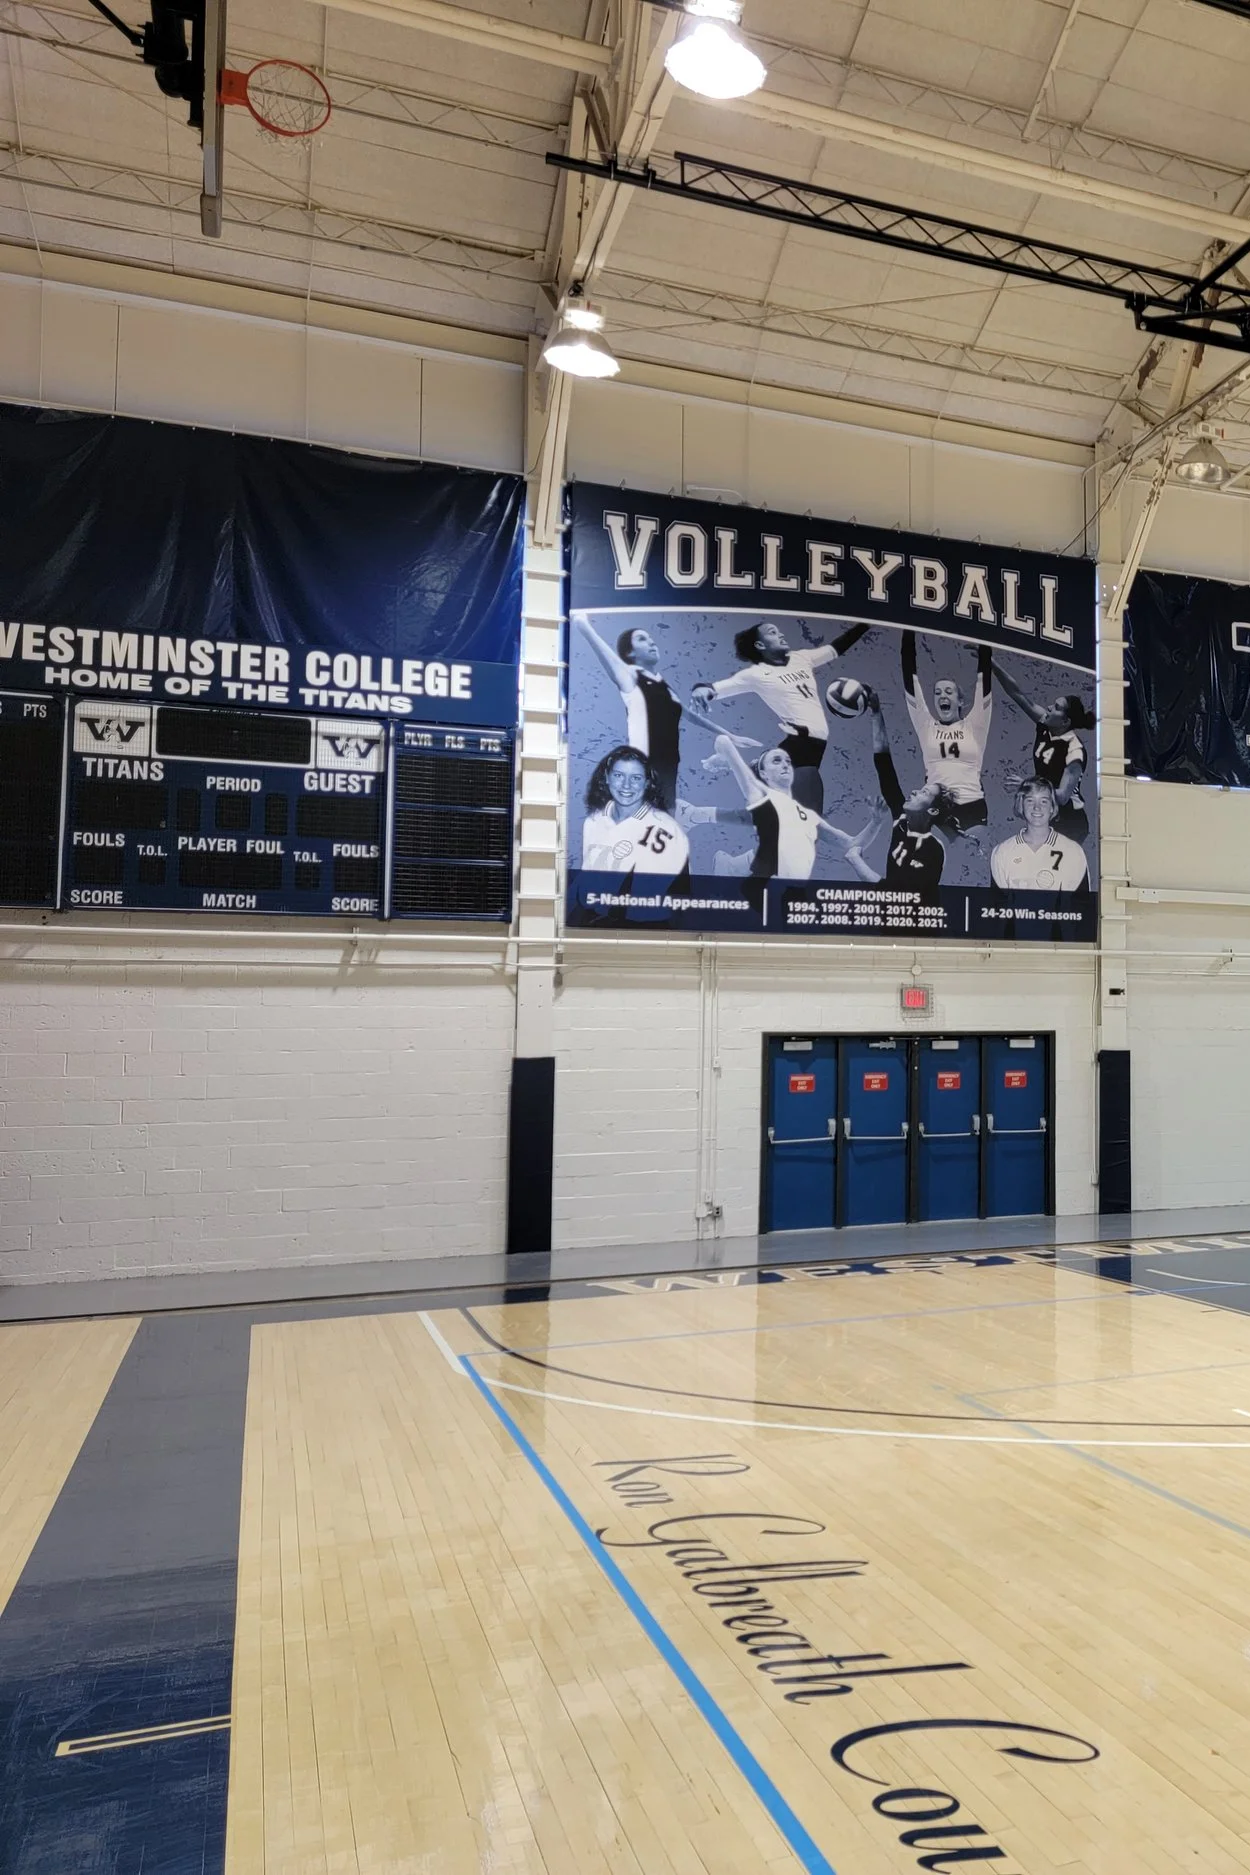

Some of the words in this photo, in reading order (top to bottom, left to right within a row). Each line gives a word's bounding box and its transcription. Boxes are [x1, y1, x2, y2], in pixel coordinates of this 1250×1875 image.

[602, 510, 1074, 648] VOLLEYBALL
[306, 651, 472, 699] COLLEGE
[778, 669, 810, 684] TITANS
[45, 667, 153, 692] HOME
[164, 677, 212, 696] OF
[222, 681, 289, 704] THE
[299, 688, 413, 714] TITANS
[23, 703, 47, 718] PTS
[404, 732, 433, 747] PLYR
[445, 735, 466, 749] FLS
[480, 737, 501, 752] PTS
[935, 729, 965, 741] TITANS
[938, 741, 960, 759] 14
[1035, 741, 1055, 765] 14
[82, 757, 164, 781] TITANS
[206, 776, 262, 793] PERIOD
[304, 771, 376, 794] GUEST
[796, 805, 808, 821] 6
[73, 832, 125, 847] FOULS
[177, 836, 237, 852] PLAYER
[246, 840, 285, 854] FOUL
[637, 825, 674, 854] 15
[137, 845, 168, 857] T.O.L.
[293, 851, 322, 863] T.O.L.
[333, 844, 379, 858] FOULS
[1050, 850, 1063, 871] 7
[70, 890, 123, 905] SCORE
[202, 893, 257, 908] MATCH
[586, 893, 661, 907] 5-National
[663, 896, 749, 911] Appearances
[816, 889, 921, 903] CHAMPIONSHIPS
[331, 898, 379, 912] SCORE
[981, 908, 1013, 919] 24-20
[1015, 909, 1036, 919] Win
[1038, 910, 1082, 921] Seasons
[592, 1454, 750, 1508] Ron
[595, 1513, 975, 1705] Galbreath
